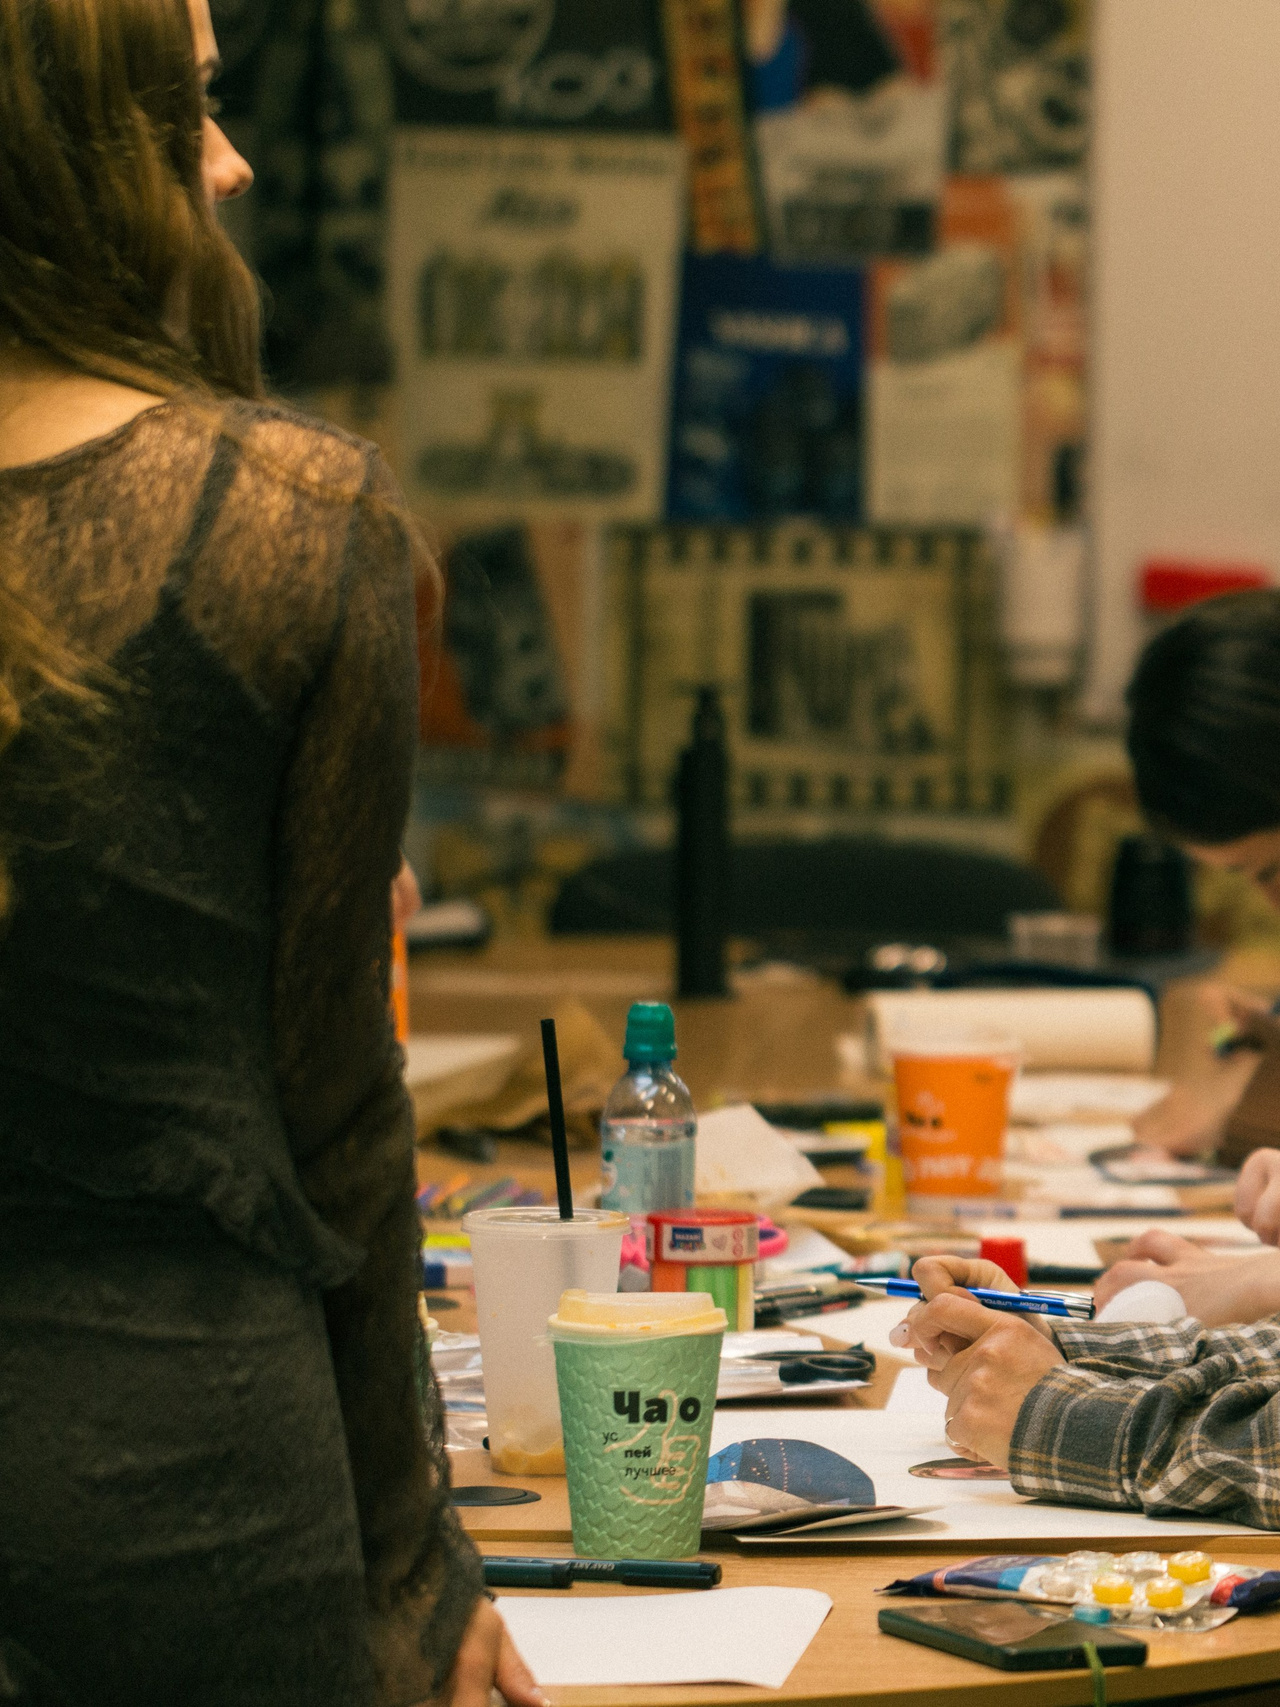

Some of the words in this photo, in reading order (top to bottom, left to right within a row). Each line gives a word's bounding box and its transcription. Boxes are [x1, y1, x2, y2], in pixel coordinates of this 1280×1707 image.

[602, 1431, 619, 1446] ус
[624, 1445, 652, 1459] пей
[624, 1467, 677, 1481] лучшее
